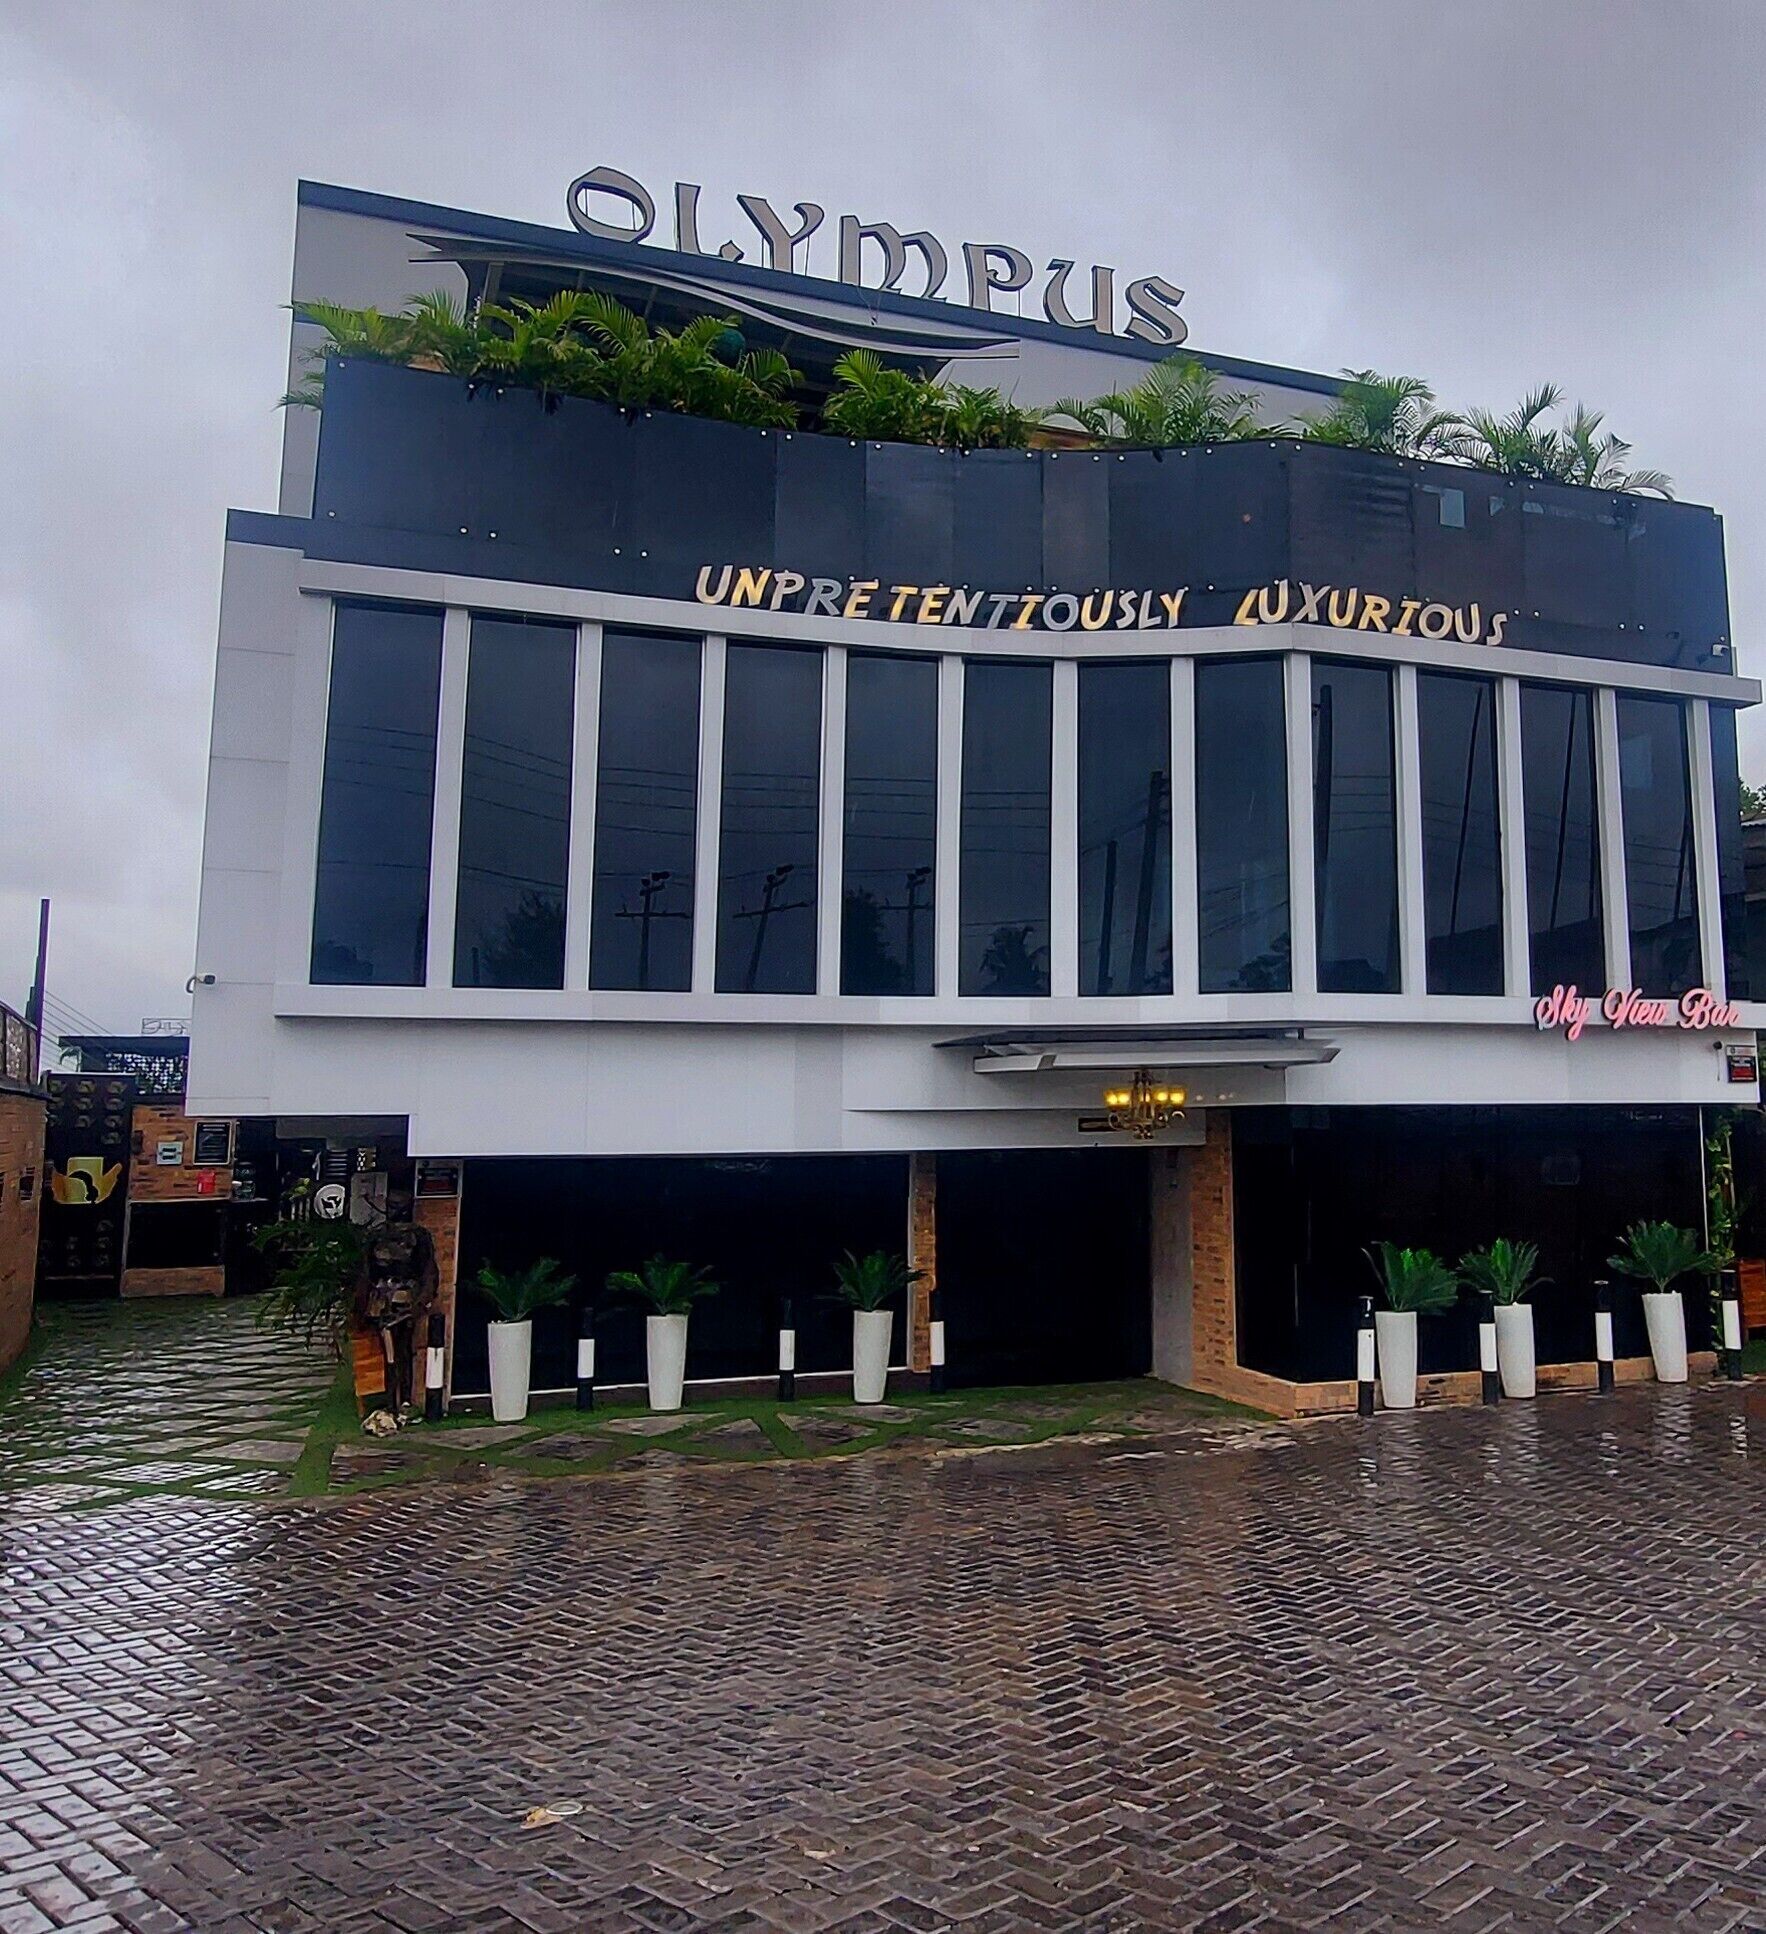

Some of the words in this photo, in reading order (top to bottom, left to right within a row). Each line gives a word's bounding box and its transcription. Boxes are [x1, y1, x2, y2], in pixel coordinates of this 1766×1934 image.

[567, 166, 1187, 346] OLYMPUS
[695, 565, 1185, 631] UNPRETENTIOUSLY
[1233, 579, 1507, 646] LUXURIOUS
[1534, 984, 1591, 1041] Sky
[1602, 988, 1670, 1030] View
[1677, 988, 1741, 1030] Bar
